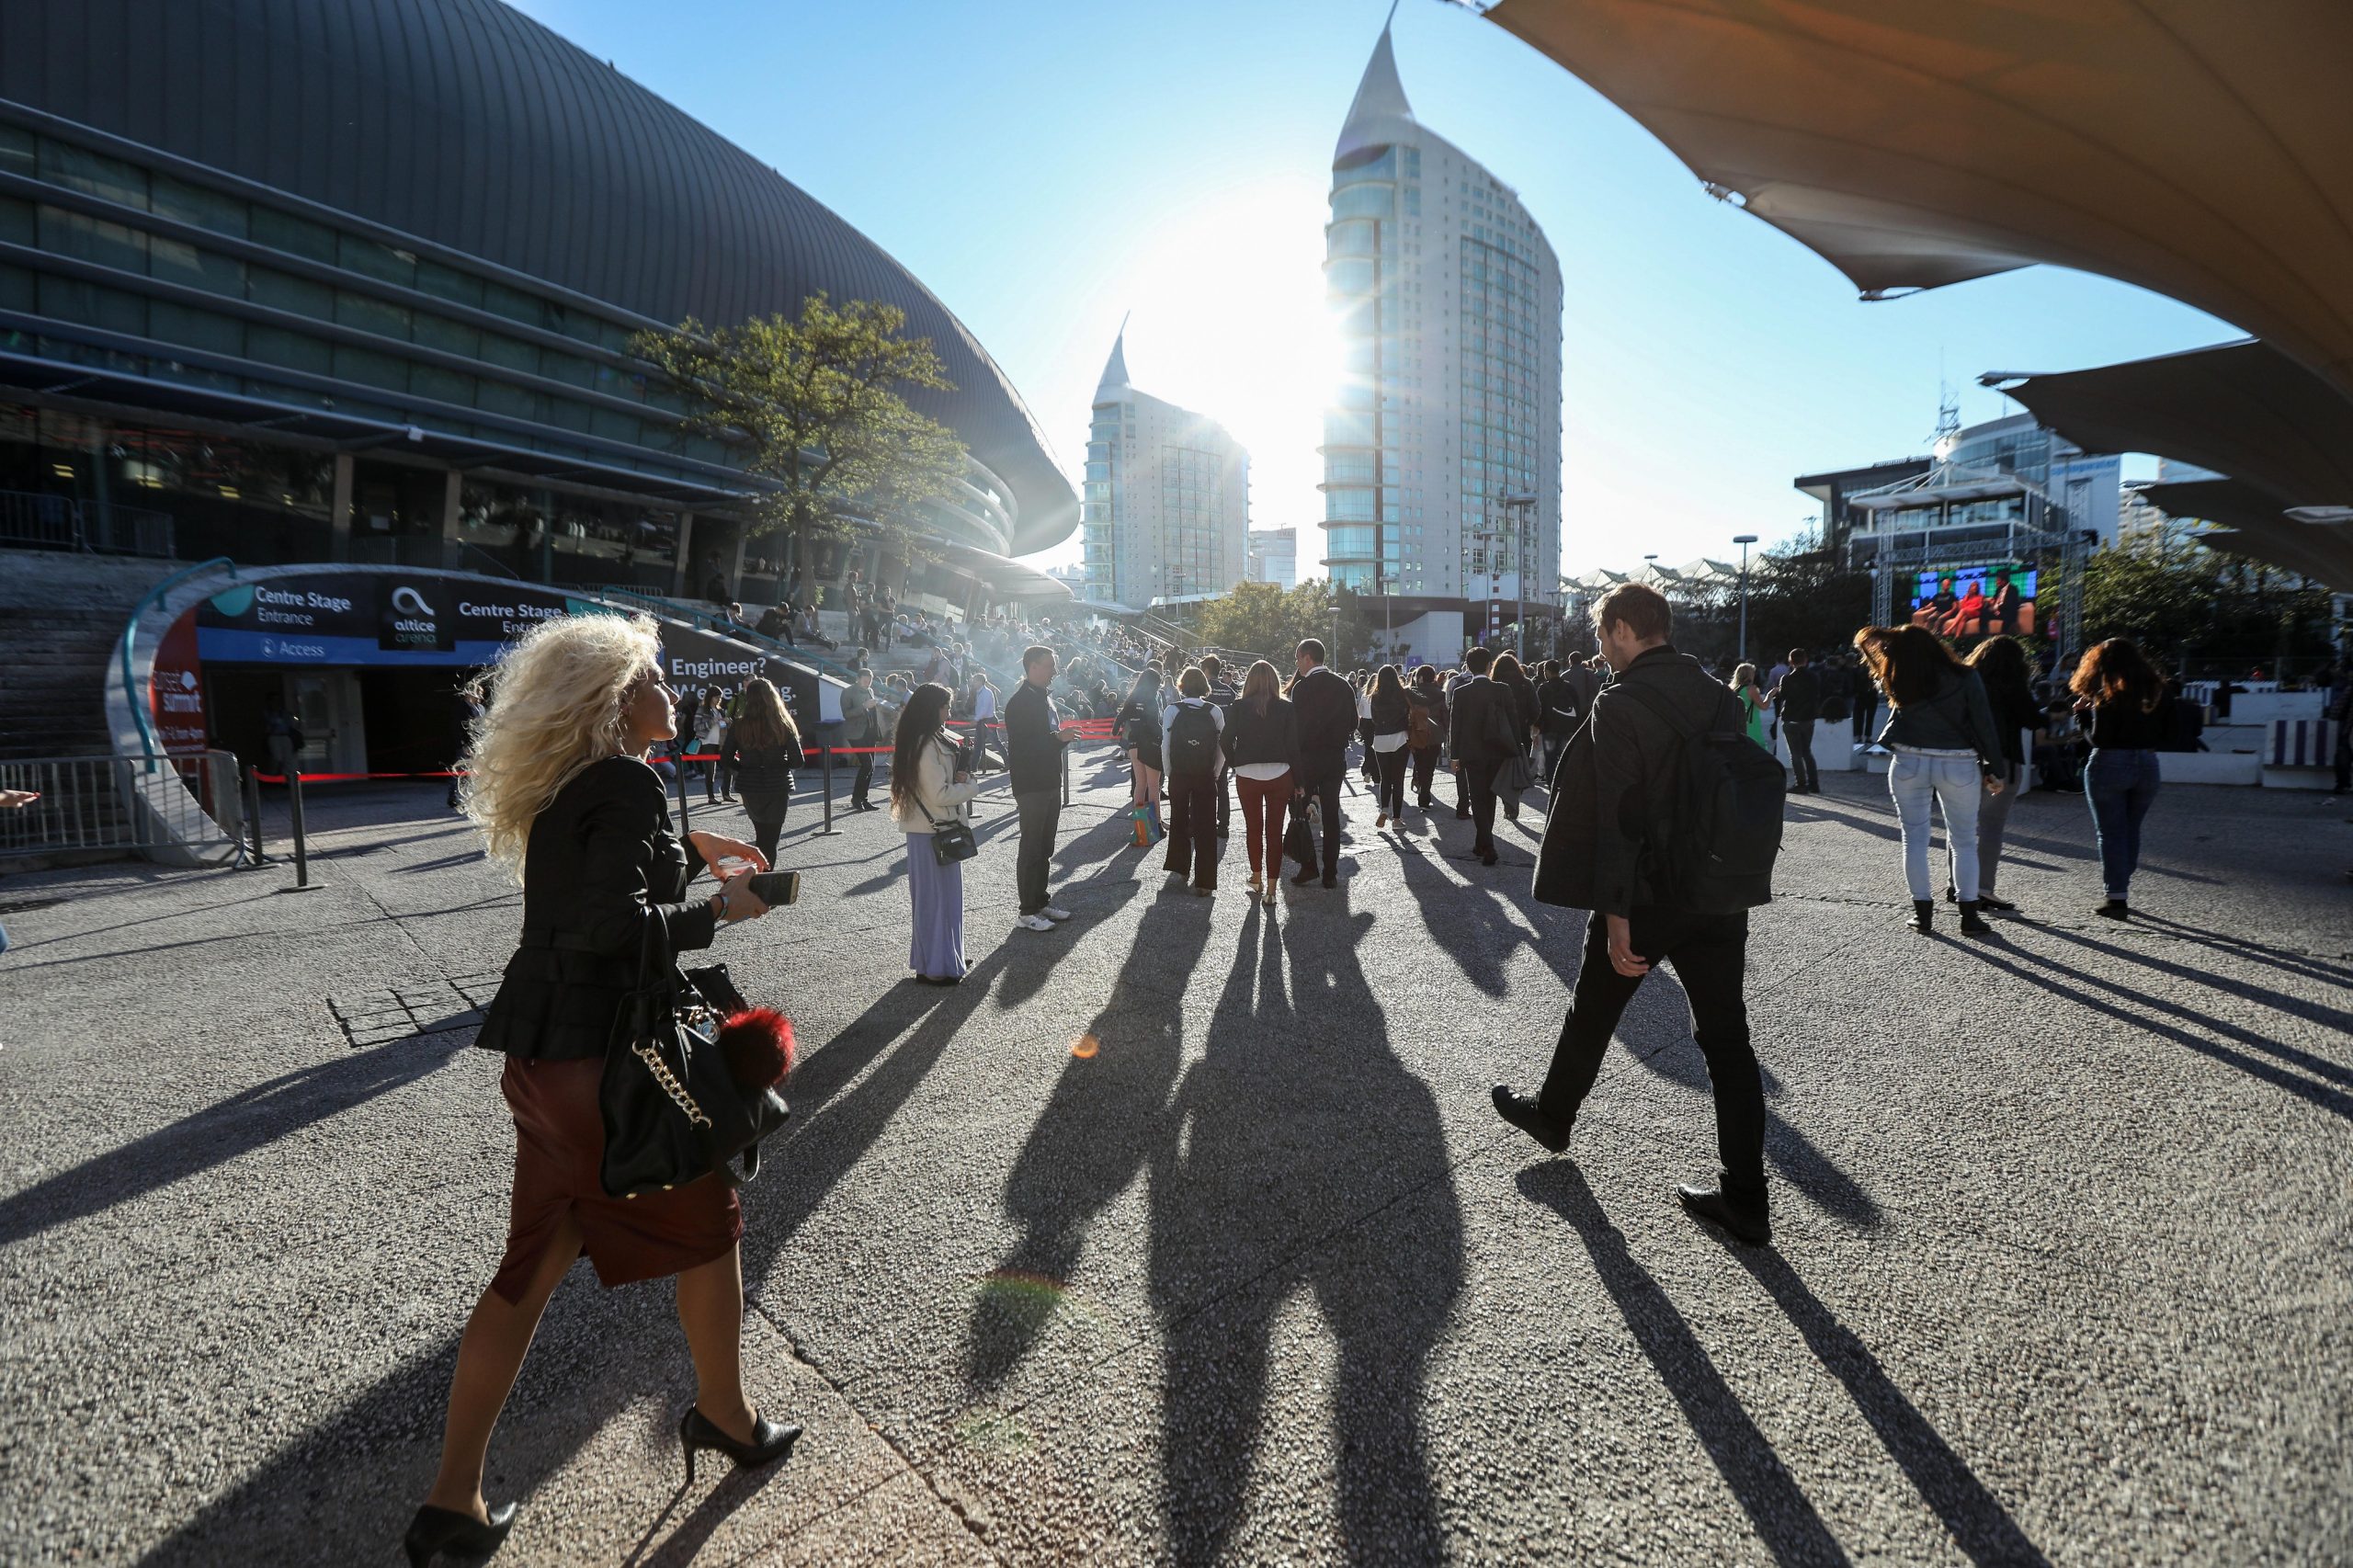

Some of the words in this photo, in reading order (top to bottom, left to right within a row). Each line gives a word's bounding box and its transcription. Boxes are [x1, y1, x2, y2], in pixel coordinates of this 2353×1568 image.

[256, 586, 304, 607] Centre
[307, 592, 351, 613] Stage
[257, 608, 313, 626] Entrance
[460, 602, 514, 617] Centre
[517, 604, 563, 619] Stage
[394, 619, 436, 632] altice
[395, 633, 437, 643] arena
[279, 641, 324, 657] Access
[672, 657, 767, 678] Engineer?
[672, 682, 733, 700] We'e
